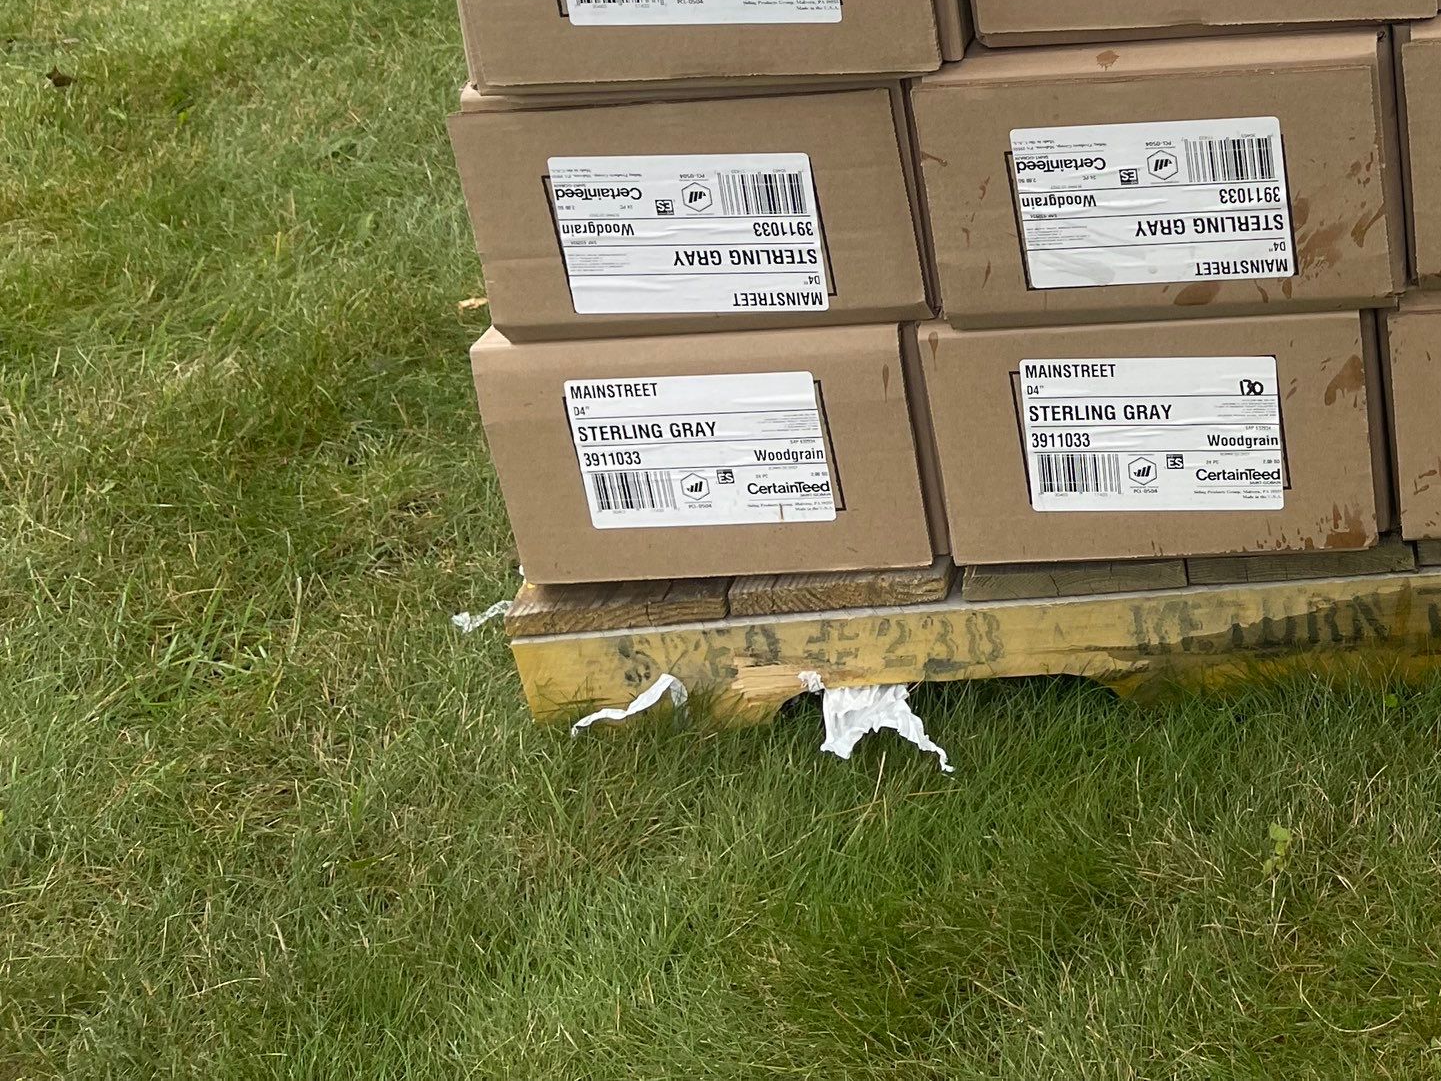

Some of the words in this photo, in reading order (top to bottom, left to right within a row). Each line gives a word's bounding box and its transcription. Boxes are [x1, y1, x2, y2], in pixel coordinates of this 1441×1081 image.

[1016, 157, 1106, 170] CertainTeed
[1120, 171, 1137, 181] ES
[555, 188, 642, 200] CertainTeed
[1022, 194, 1096, 208] Woodgrain
[1219, 187, 1280, 203] 3911033
[657, 201, 673, 211] ES
[563, 222, 634, 236] Woodgrain
[753, 222, 813, 236] 3911033
[1136, 219, 1185, 236] GRAY
[1193, 214, 1283, 233] STERLING
[1269, 241, 1286, 251] D4"
[674, 250, 721, 266] GRAY
[729, 249, 817, 265] STERLING
[1195, 259, 1288, 275] MAINSTREET
[804, 275, 820, 285] D4"
[733, 292, 822, 306] MAINSTREET
[1025, 364, 1115, 378] MAINSTREET
[571, 383, 657, 398] MAINSTREET
[1027, 385, 1044, 395] D4"
[573, 406, 589, 416] D4"
[1030, 405, 1115, 421] STERLING
[1124, 405, 1171, 420] GRAY
[578, 424, 666, 444] STERLING
[670, 422, 715, 437] GRAY
[1032, 433, 1090, 447] 3911033
[1207, 435, 1278, 449] Woodgrain
[584, 451, 641, 466] 3911033
[754, 449, 823, 465] Woodgrain
[1168, 458, 1183, 468] ES
[718, 473, 733, 483] ES
[1196, 469, 1280, 480] CertainTeed
[747, 481, 830, 495] CertainTeed
